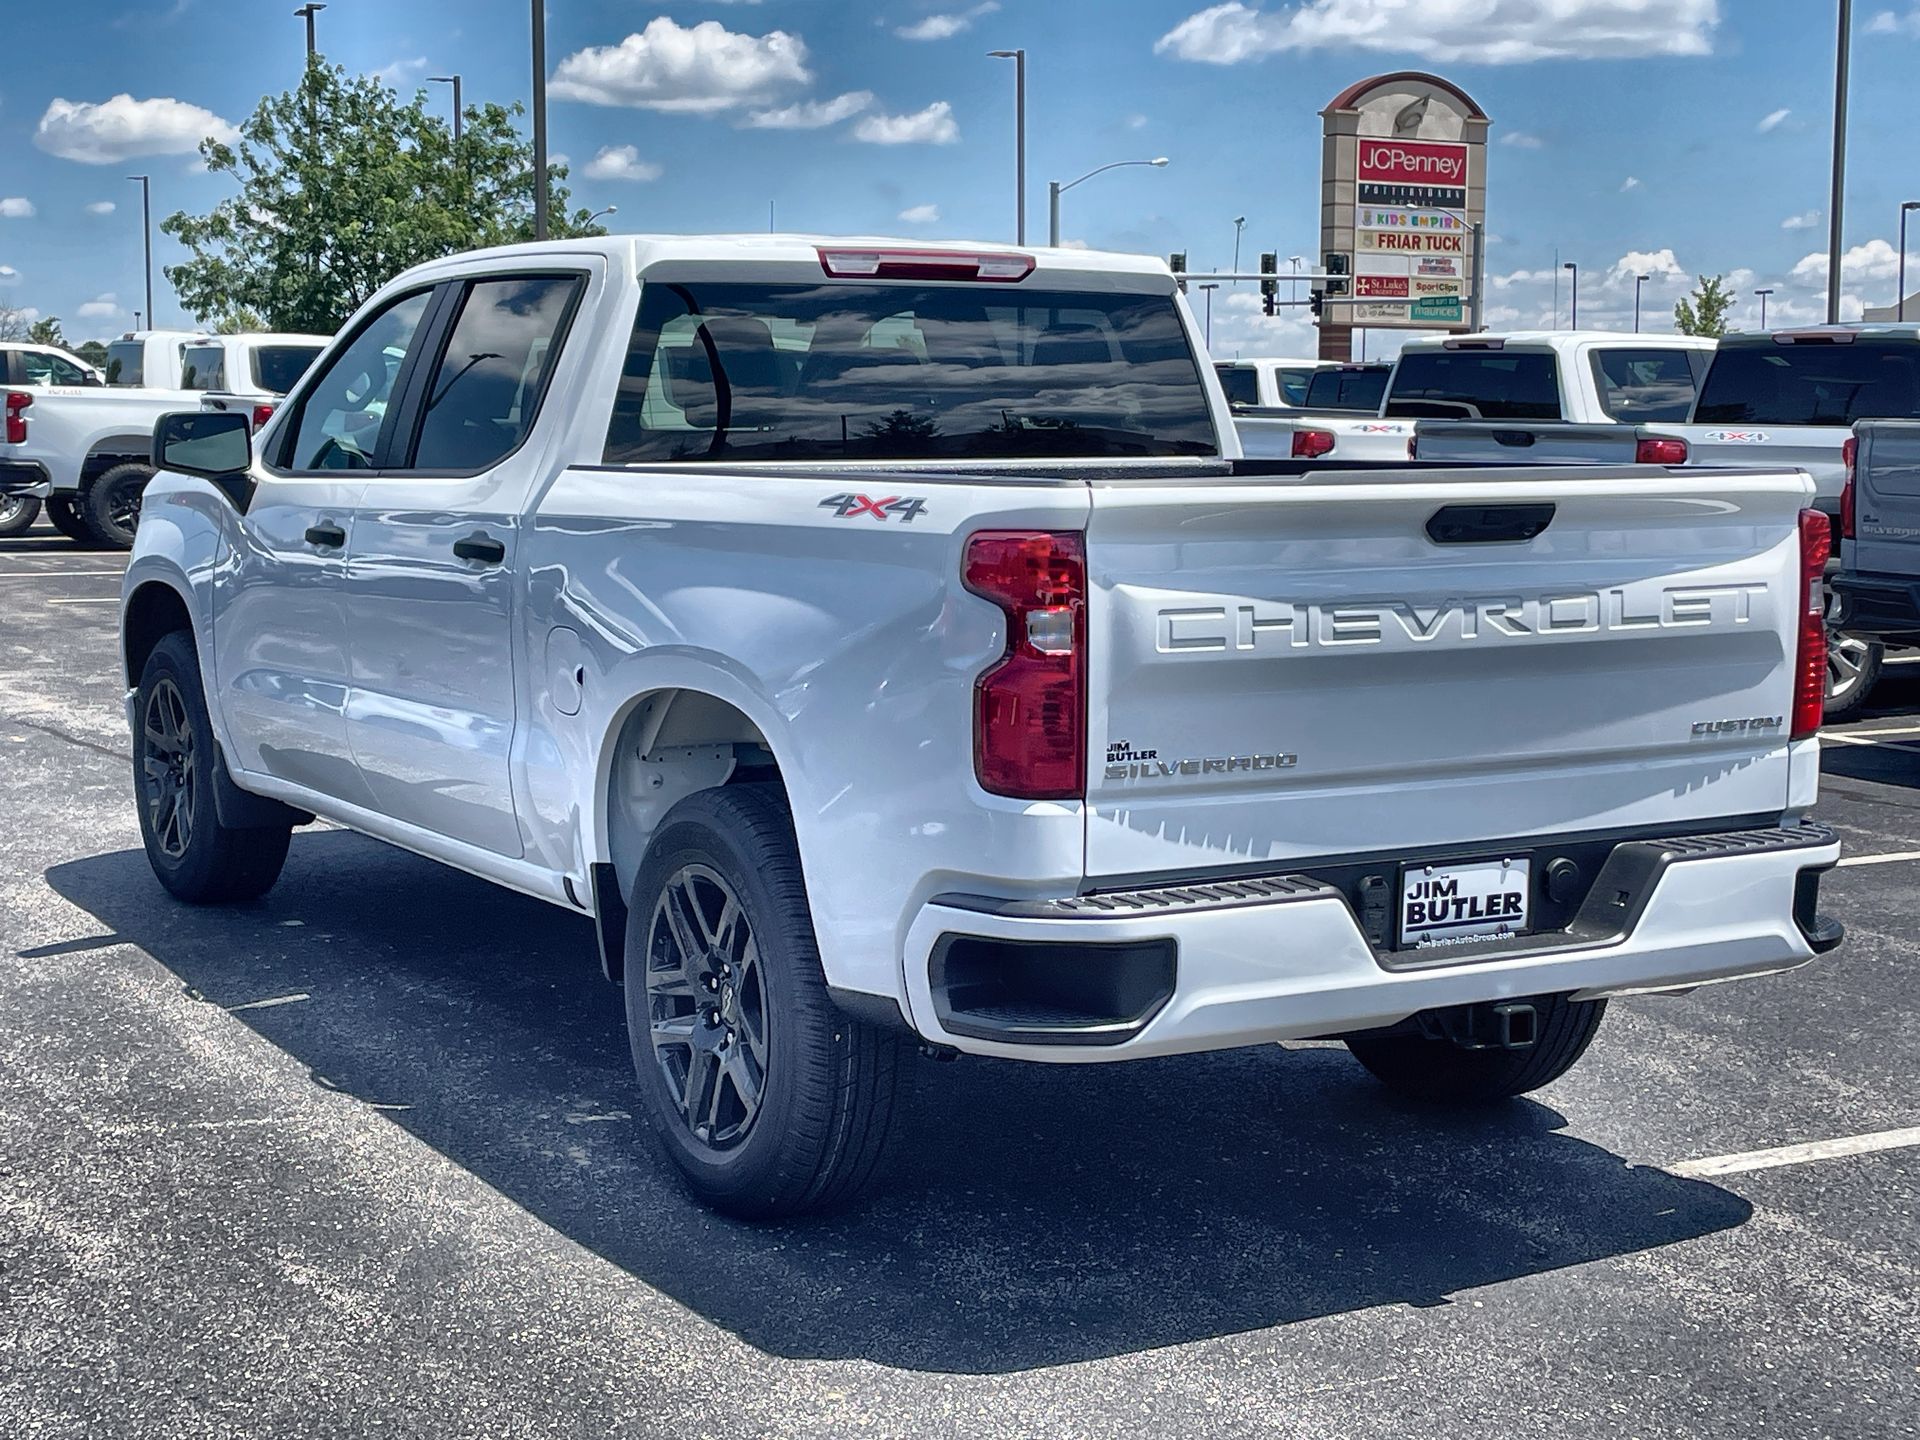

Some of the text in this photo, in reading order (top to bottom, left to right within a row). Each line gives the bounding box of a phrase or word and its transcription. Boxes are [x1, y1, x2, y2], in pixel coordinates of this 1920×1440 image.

[1362, 147, 1463, 179] JCPenney
[1377, 213, 1461, 229] KIDS EMPIRE
[1377, 233, 1461, 252] FRIAR TUCK
[1370, 279, 1408, 290] St. Luke's
[1415, 307, 1458, 317] maurices
[1155, 582, 1769, 654] CHEVROLET
[1692, 716, 1783, 734] CUSTOM
[1106, 742, 1130, 752] JIM
[1106, 750, 1157, 762] BUTLER
[1104, 752, 1298, 780] SILVERADO
[1407, 879, 1458, 900] JIM
[1406, 891, 1523, 925] BUTLER
[1415, 931, 1515, 950] JimButlerAutoGroup.com
